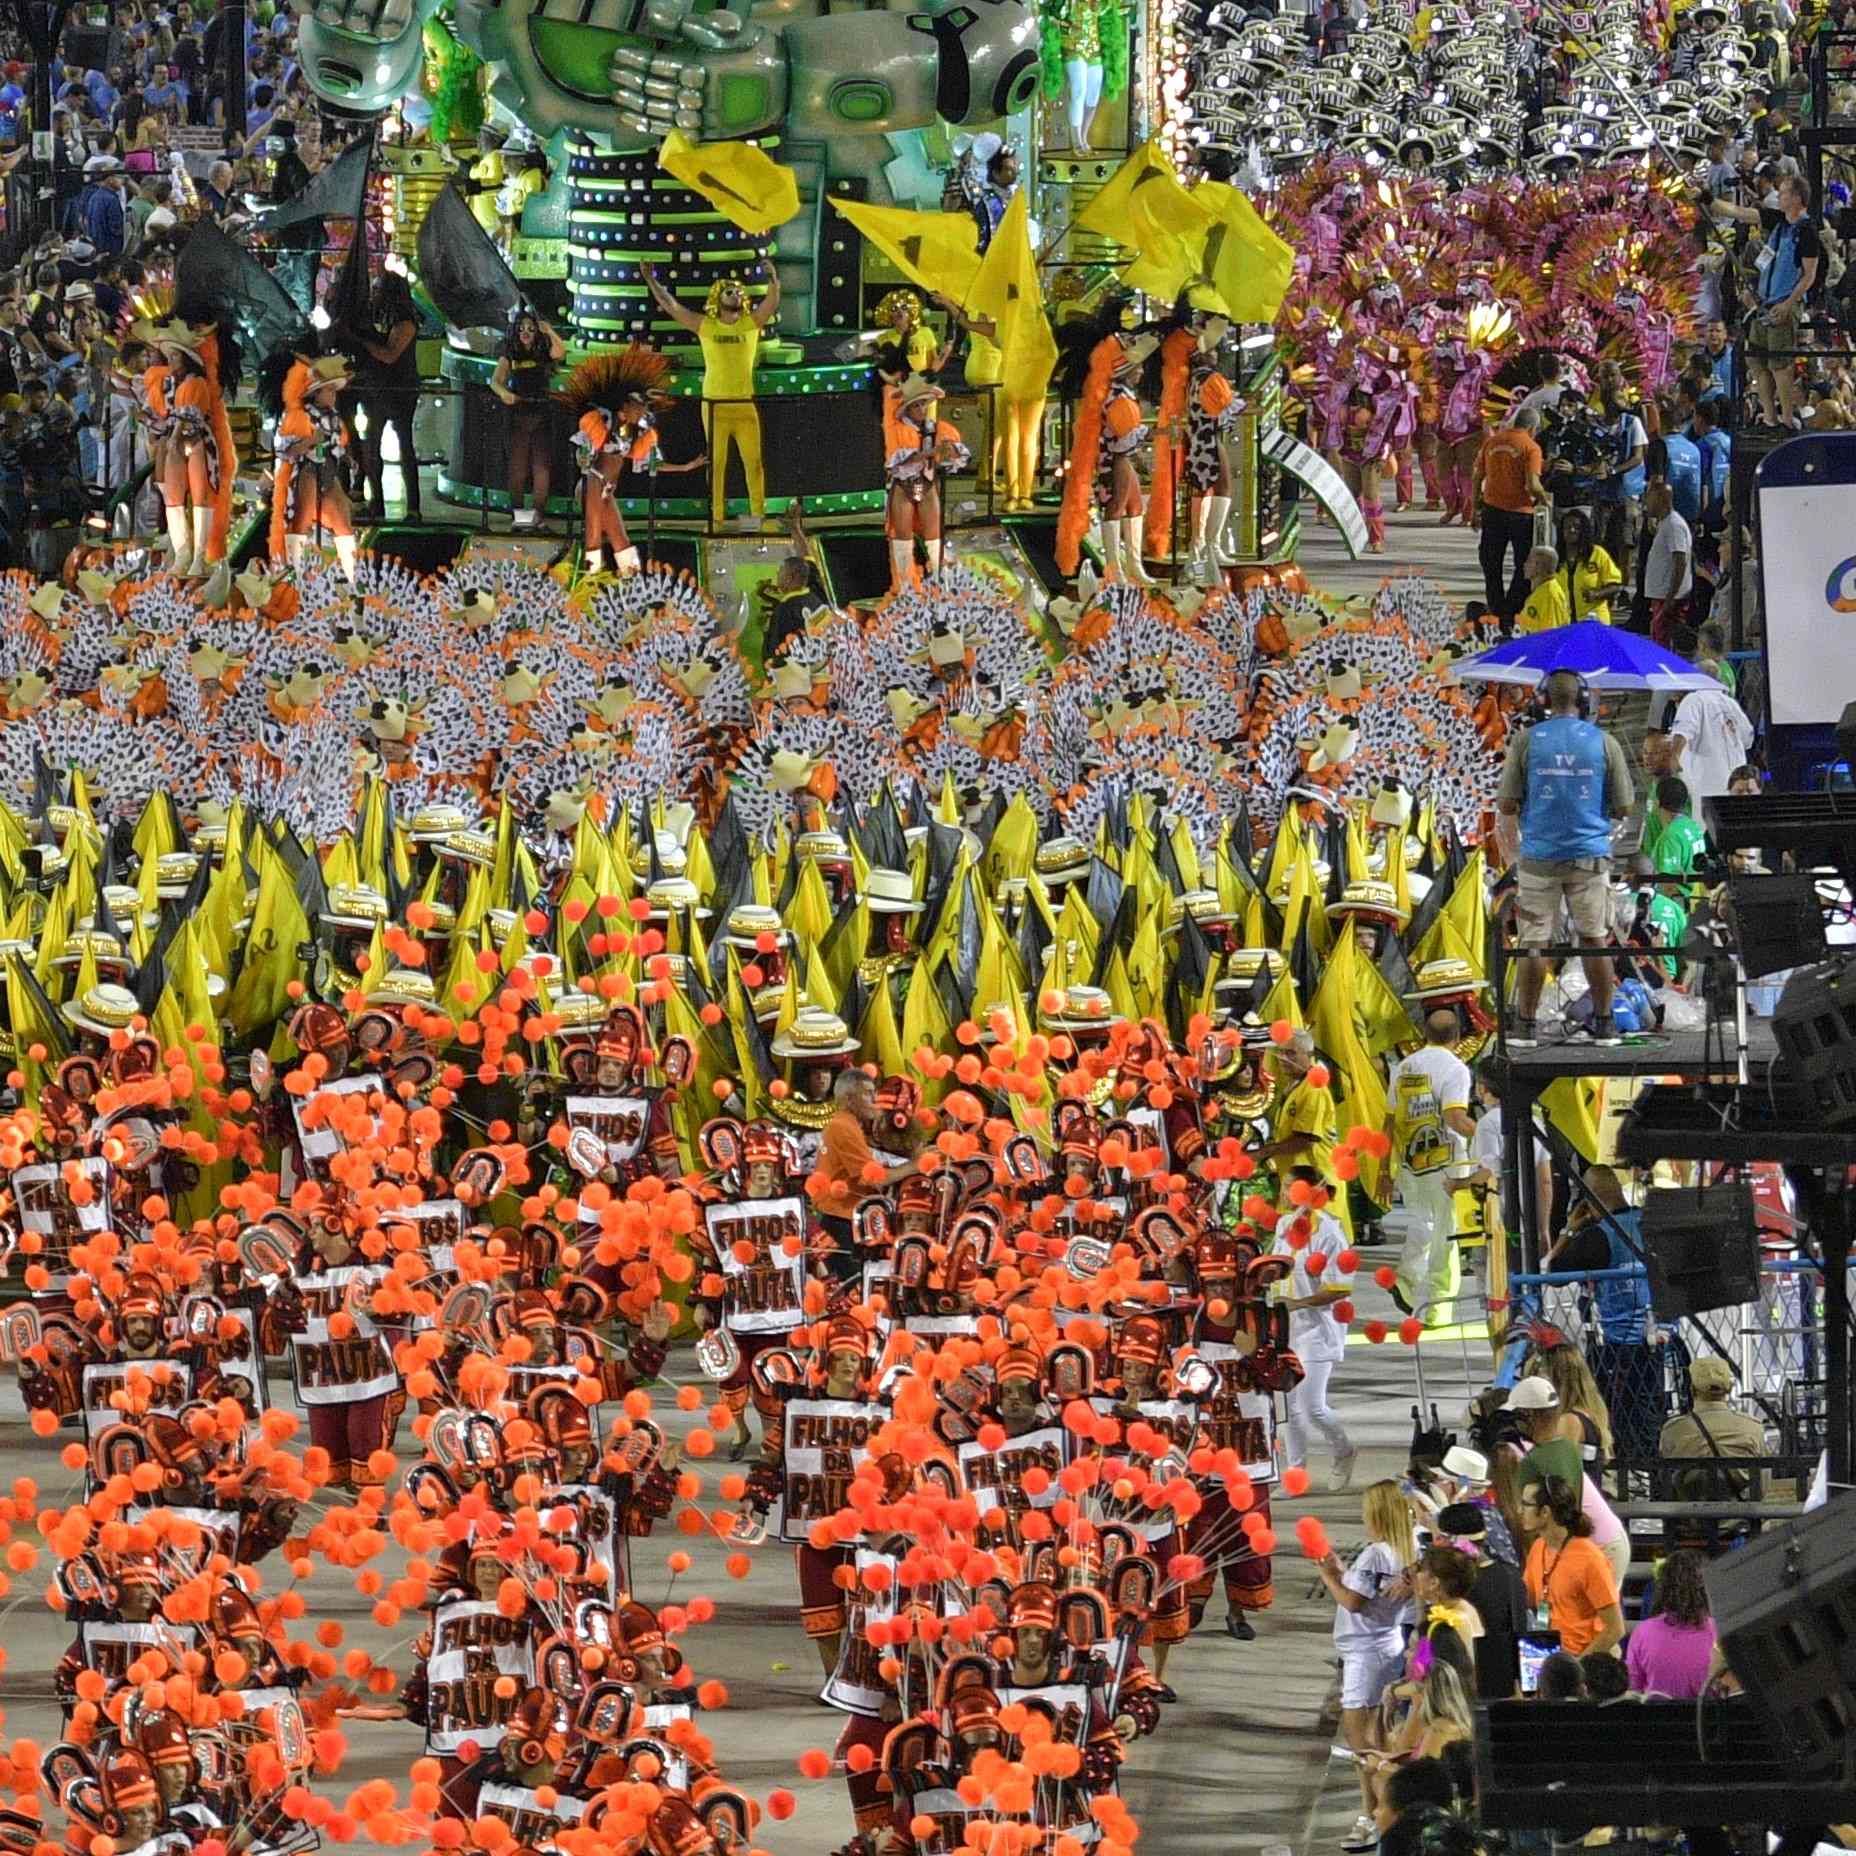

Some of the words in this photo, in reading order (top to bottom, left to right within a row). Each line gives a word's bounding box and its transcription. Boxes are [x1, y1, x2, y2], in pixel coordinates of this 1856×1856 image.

[1554, 753, 1576, 767] TV
[712, 1209, 802, 1253] FILHOS
[295, 1337, 393, 1387] PAUTA
[821, 1447, 855, 1473] DA
[962, 1441, 1061, 1490] FILHOS
[463, 1648, 501, 1677] DA
